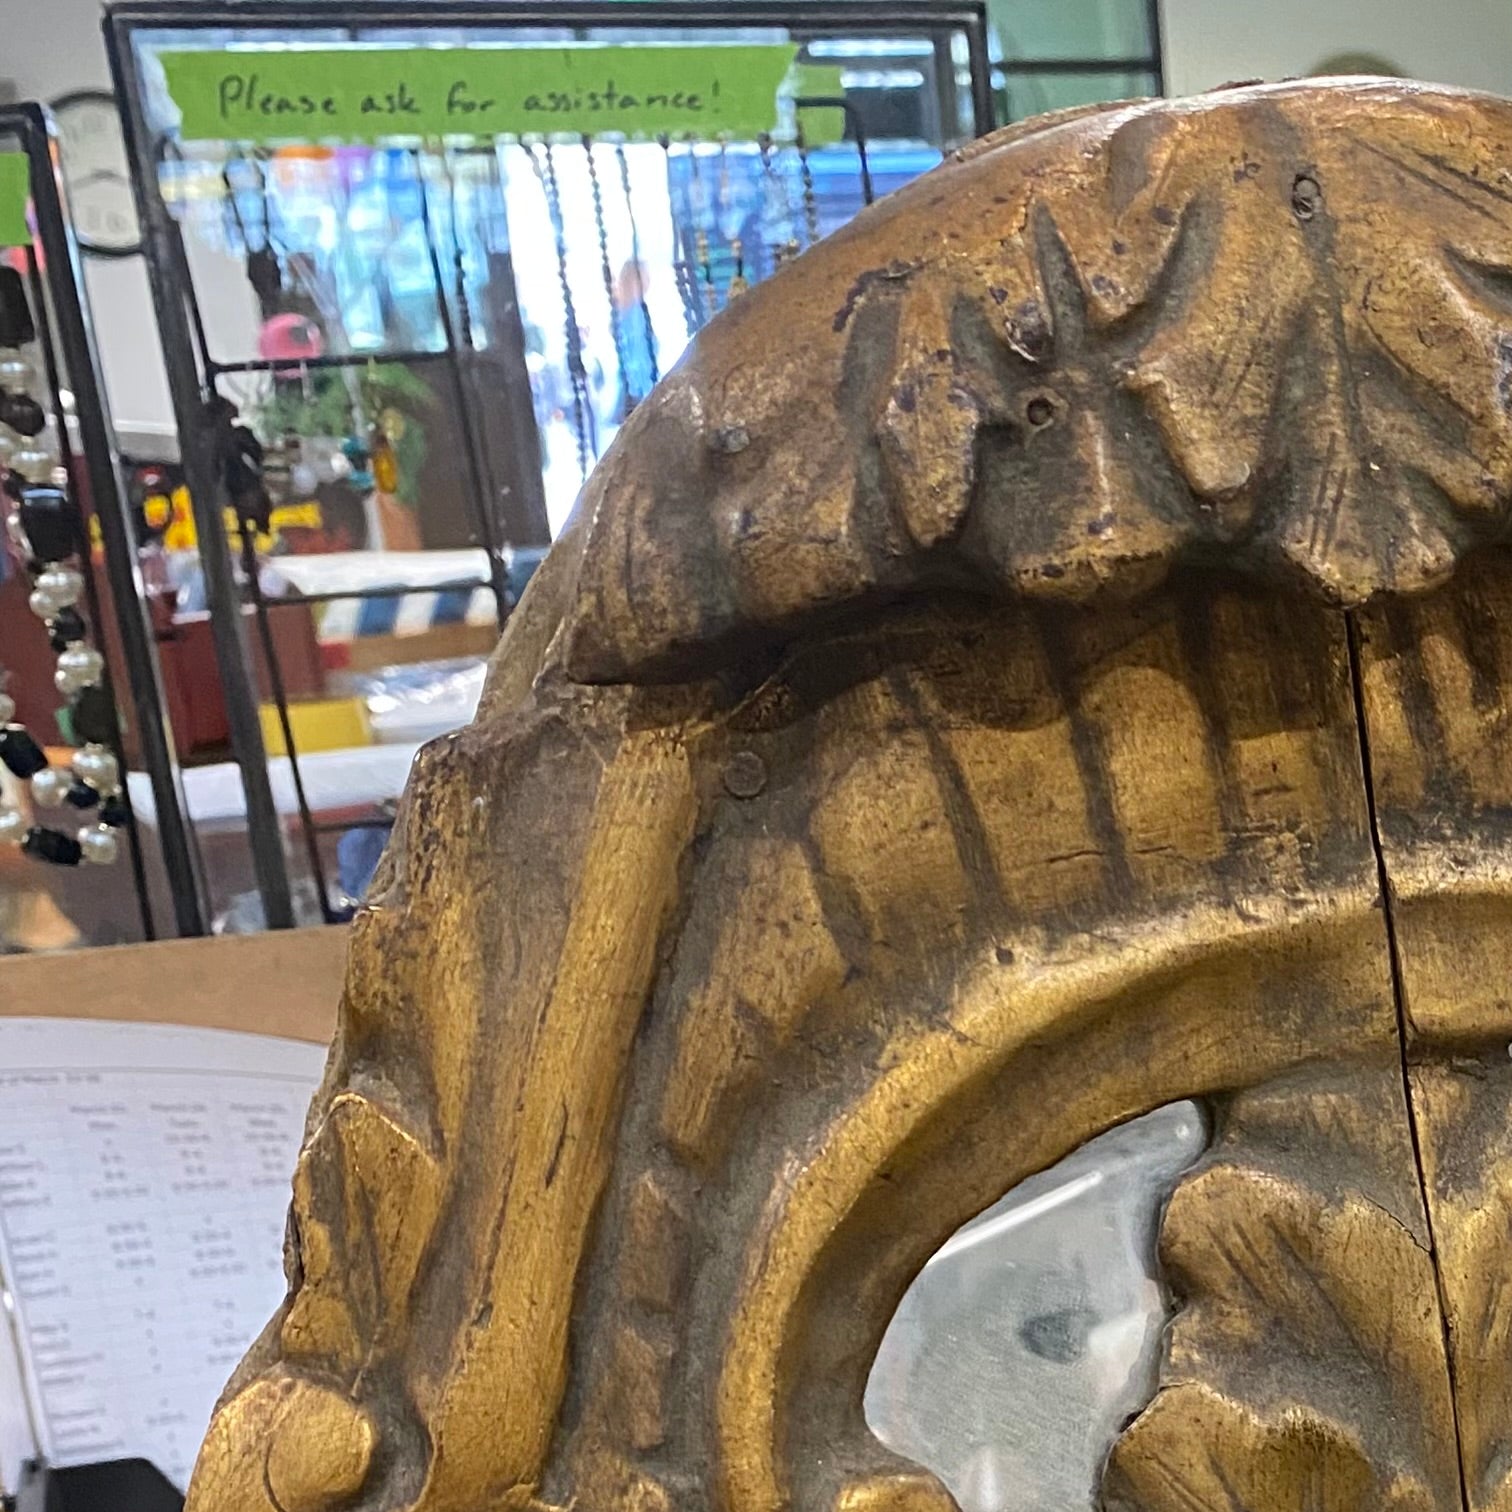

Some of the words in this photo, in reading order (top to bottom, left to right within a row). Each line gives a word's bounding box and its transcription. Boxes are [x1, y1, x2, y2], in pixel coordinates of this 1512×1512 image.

[217, 74, 338, 118] Please
[360, 89, 422, 116] ask
[443, 80, 498, 117] for
[522, 80, 724, 113] assistance!
